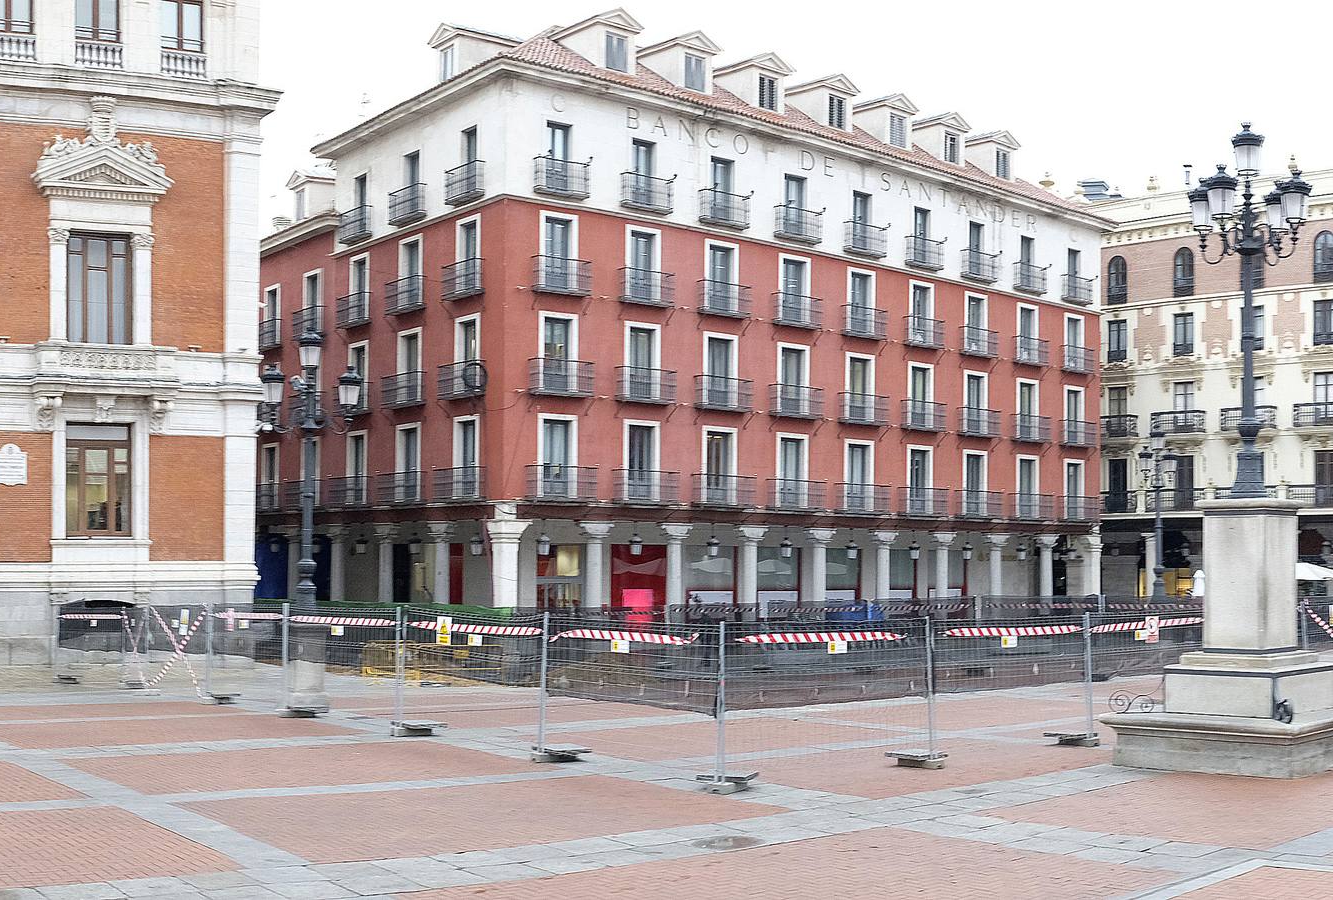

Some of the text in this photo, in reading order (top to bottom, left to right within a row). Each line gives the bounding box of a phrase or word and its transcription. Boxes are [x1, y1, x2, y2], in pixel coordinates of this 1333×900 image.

[625, 106, 1039, 233] BANCO DE SANTANDER
